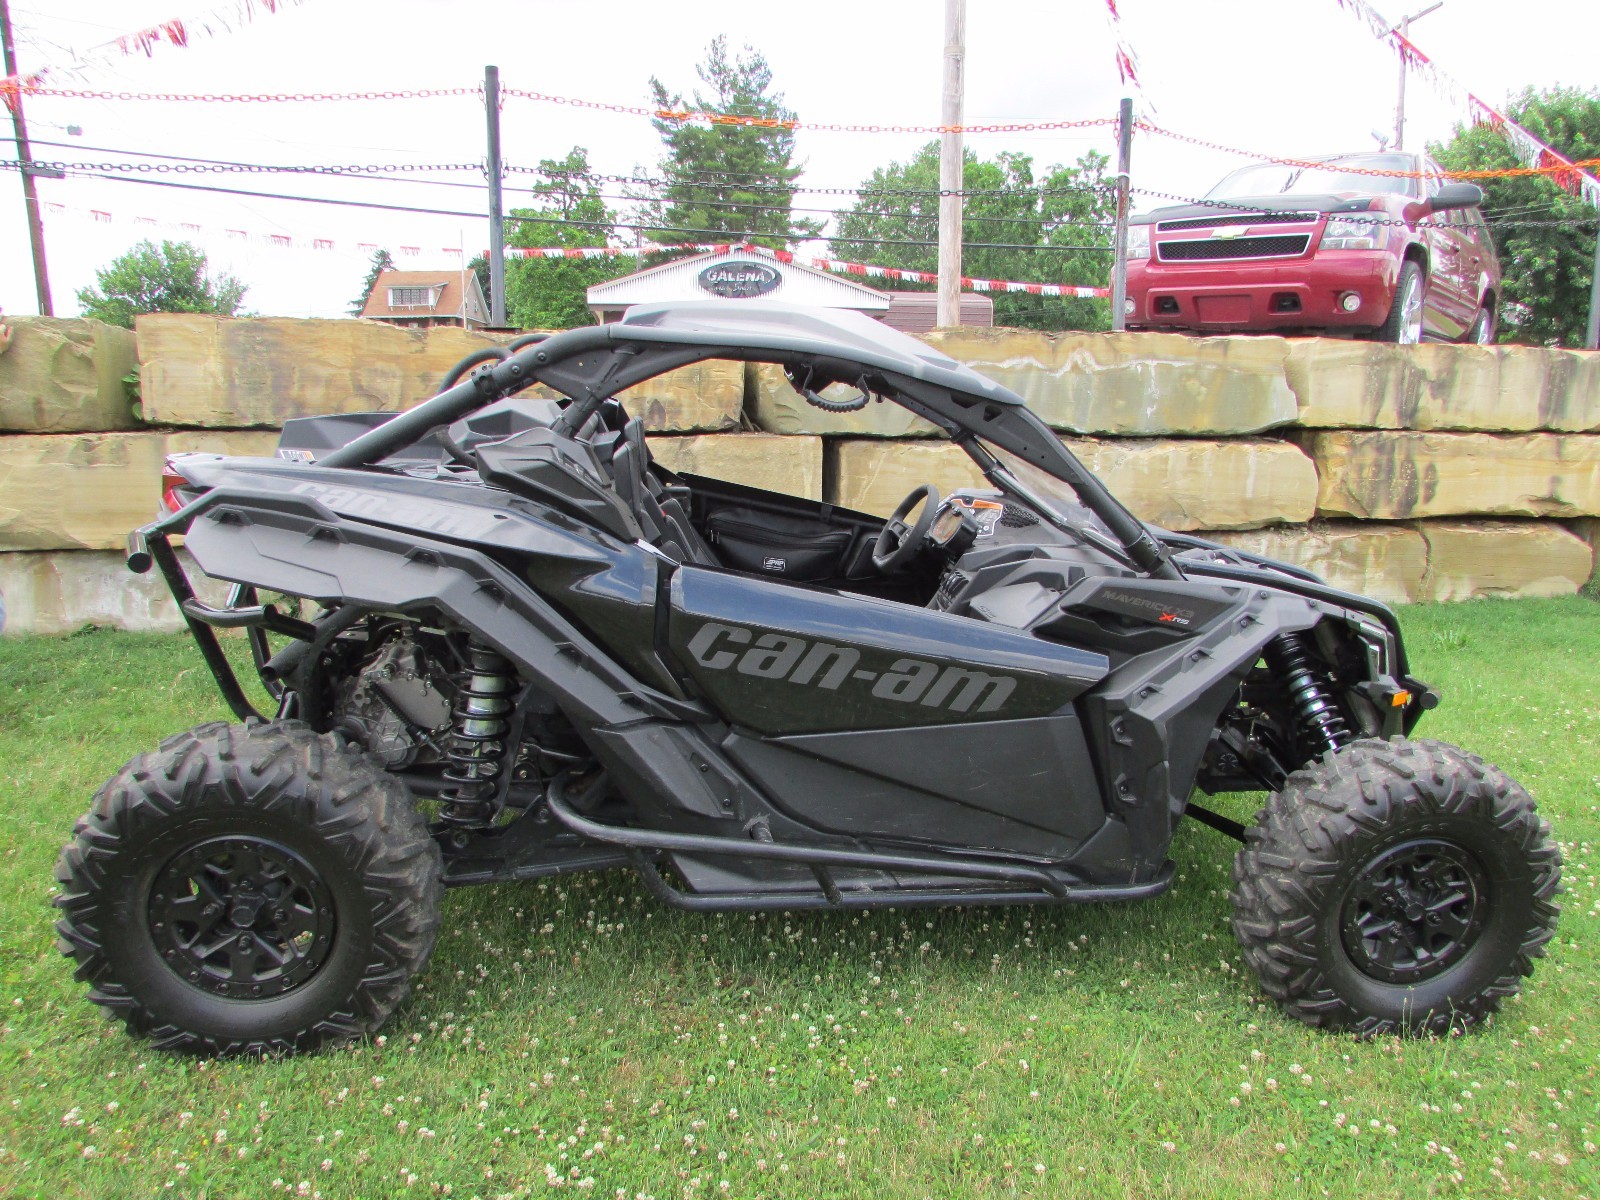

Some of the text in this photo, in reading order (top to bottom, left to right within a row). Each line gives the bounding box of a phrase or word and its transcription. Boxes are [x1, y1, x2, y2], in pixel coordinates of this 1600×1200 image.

[706, 270, 765, 283] GALENA
[1102, 590, 1173, 613] MAVERICK
[687, 622, 1017, 713] can-am
